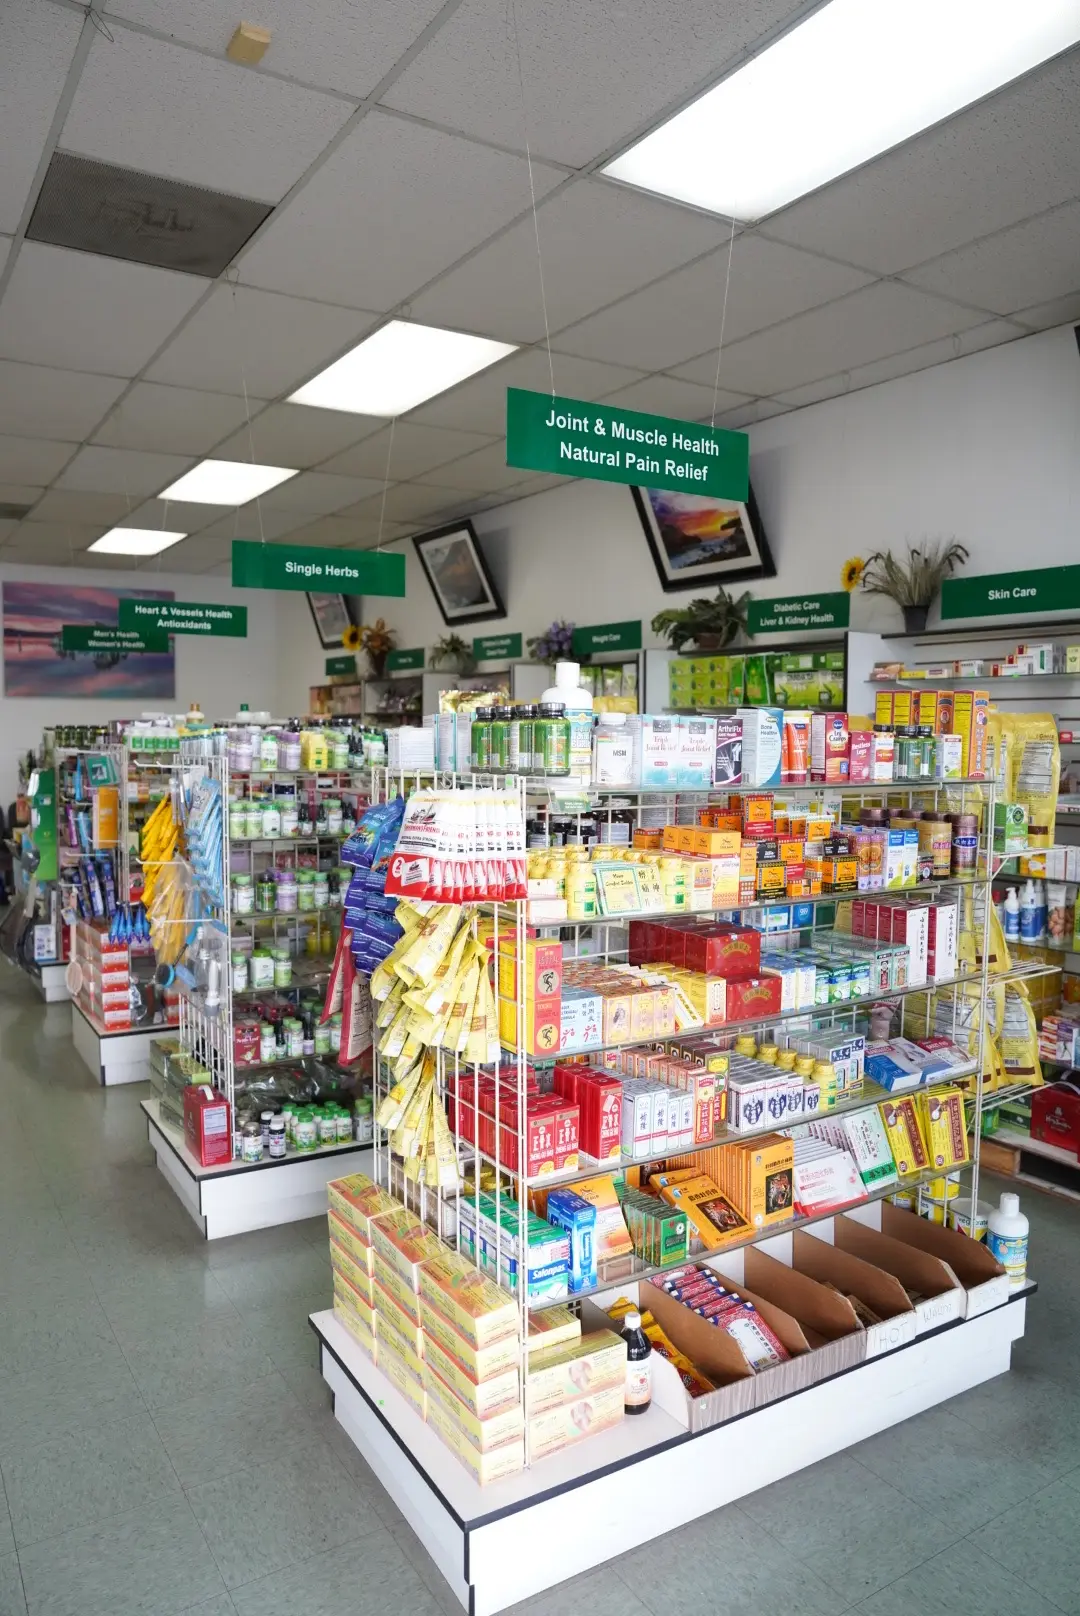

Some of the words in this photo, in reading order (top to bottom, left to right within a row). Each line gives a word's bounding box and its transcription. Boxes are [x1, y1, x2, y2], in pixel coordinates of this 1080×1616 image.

[545, 410, 589, 433] Joint
[593, 418, 607, 436] &
[611, 421, 668, 447] Muscle
[671, 432, 720, 456] Health
[559, 441, 620, 467] Natural
[625, 452, 660, 474] Pain
[664, 459, 709, 481] Relief
[285, 561, 323, 576] Single
[325, 564, 360, 578] Herbs
[987, 589, 1010, 600] Skin
[1012, 587, 1037, 598] Care
[134, 604, 159, 615] Heart
[160, 606, 168, 615] &
[170, 607, 204, 618] Vessels
[205, 608, 233, 619] Health
[773, 602, 802, 612] Diabetic
[802, 601, 820, 610] Care
[156, 618, 212, 630] Antioxidants
[760, 617, 777, 626] Liver
[778, 617, 783, 625] &
[784, 616, 810, 626] Kidney
[810, 613, 834, 623] Health
[93, 629, 115, 638] Men's
[116, 630, 140, 639] Health
[87, 639, 121, 648] Women's
[122, 640, 145, 649] Health
[612, 749, 627, 757] MSM
[532, 1263, 566, 1280] Salonpas
[878, 1321, 909, 1350] HOT
